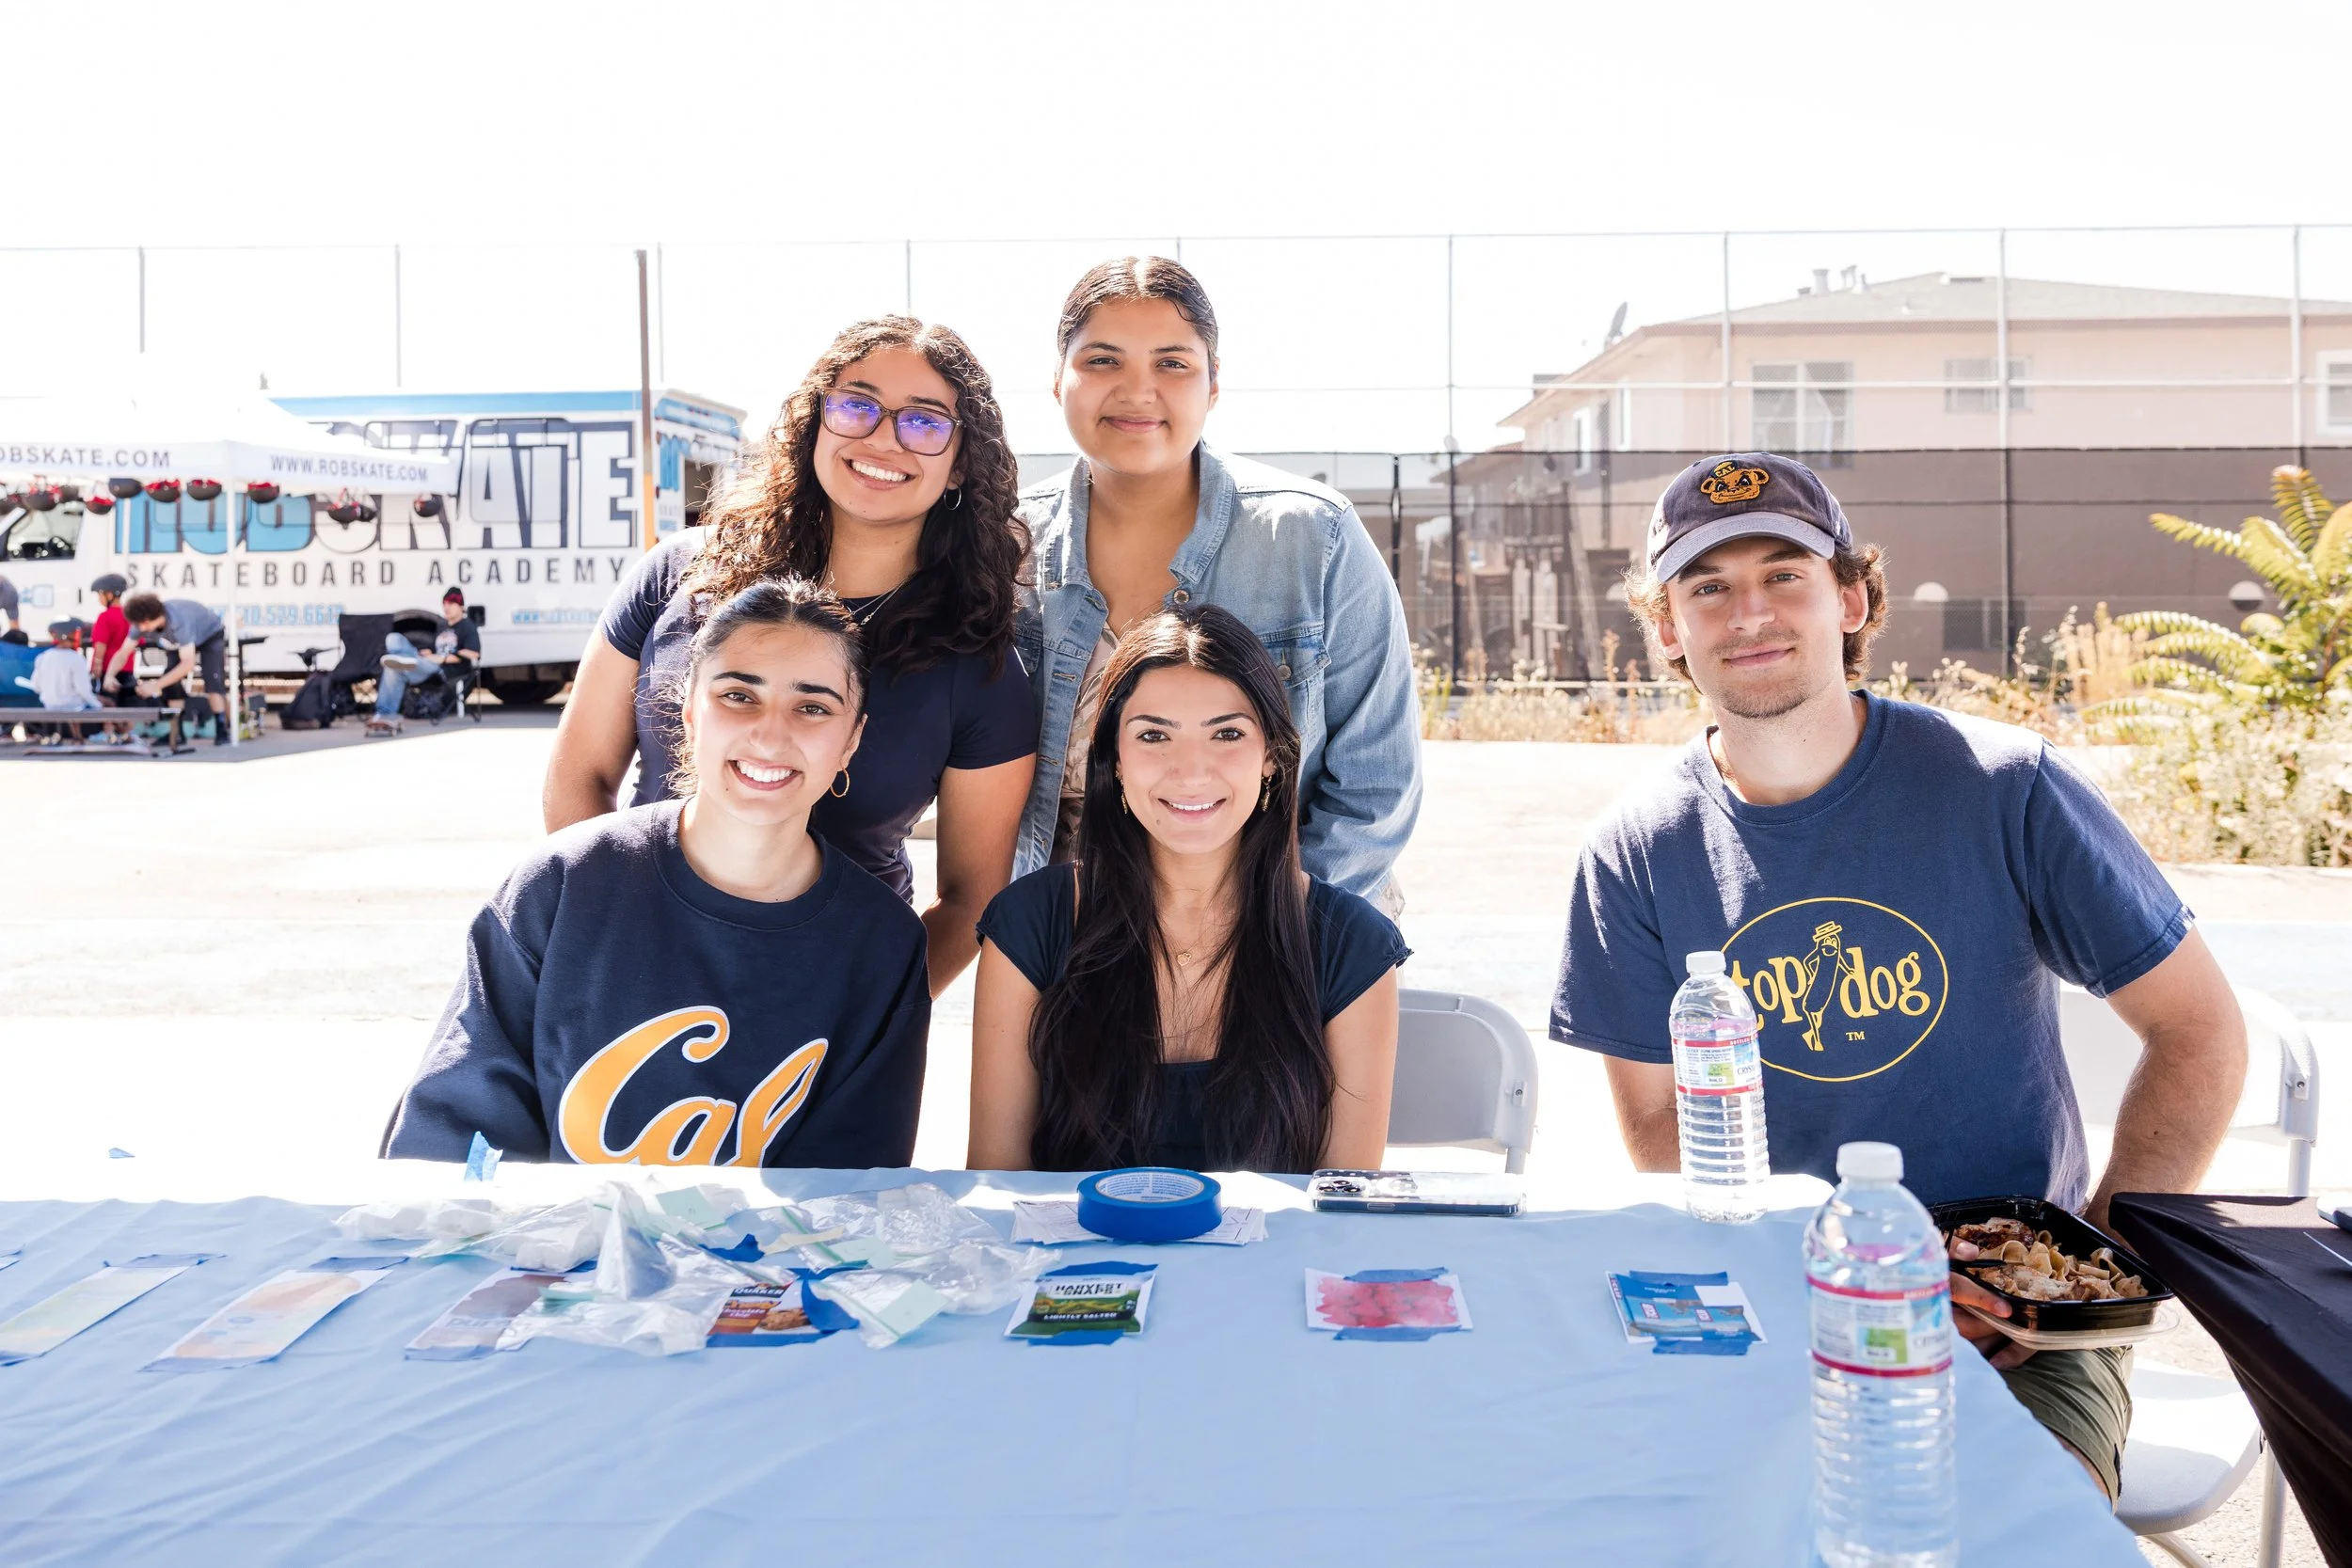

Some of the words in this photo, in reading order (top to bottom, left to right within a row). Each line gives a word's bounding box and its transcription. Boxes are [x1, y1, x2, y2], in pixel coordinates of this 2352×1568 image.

[270, 454, 428, 483] WWW.ROBSKATE.COM
[1714, 465, 1736, 478] CAL
[128, 560, 395, 589] SKATEBOARD
[428, 557, 626, 585] ACADEMY
[1839, 945, 1931, 1019] dog
[1845, 1030, 1866, 1042] TM
[558, 1005, 830, 1168] Cal
